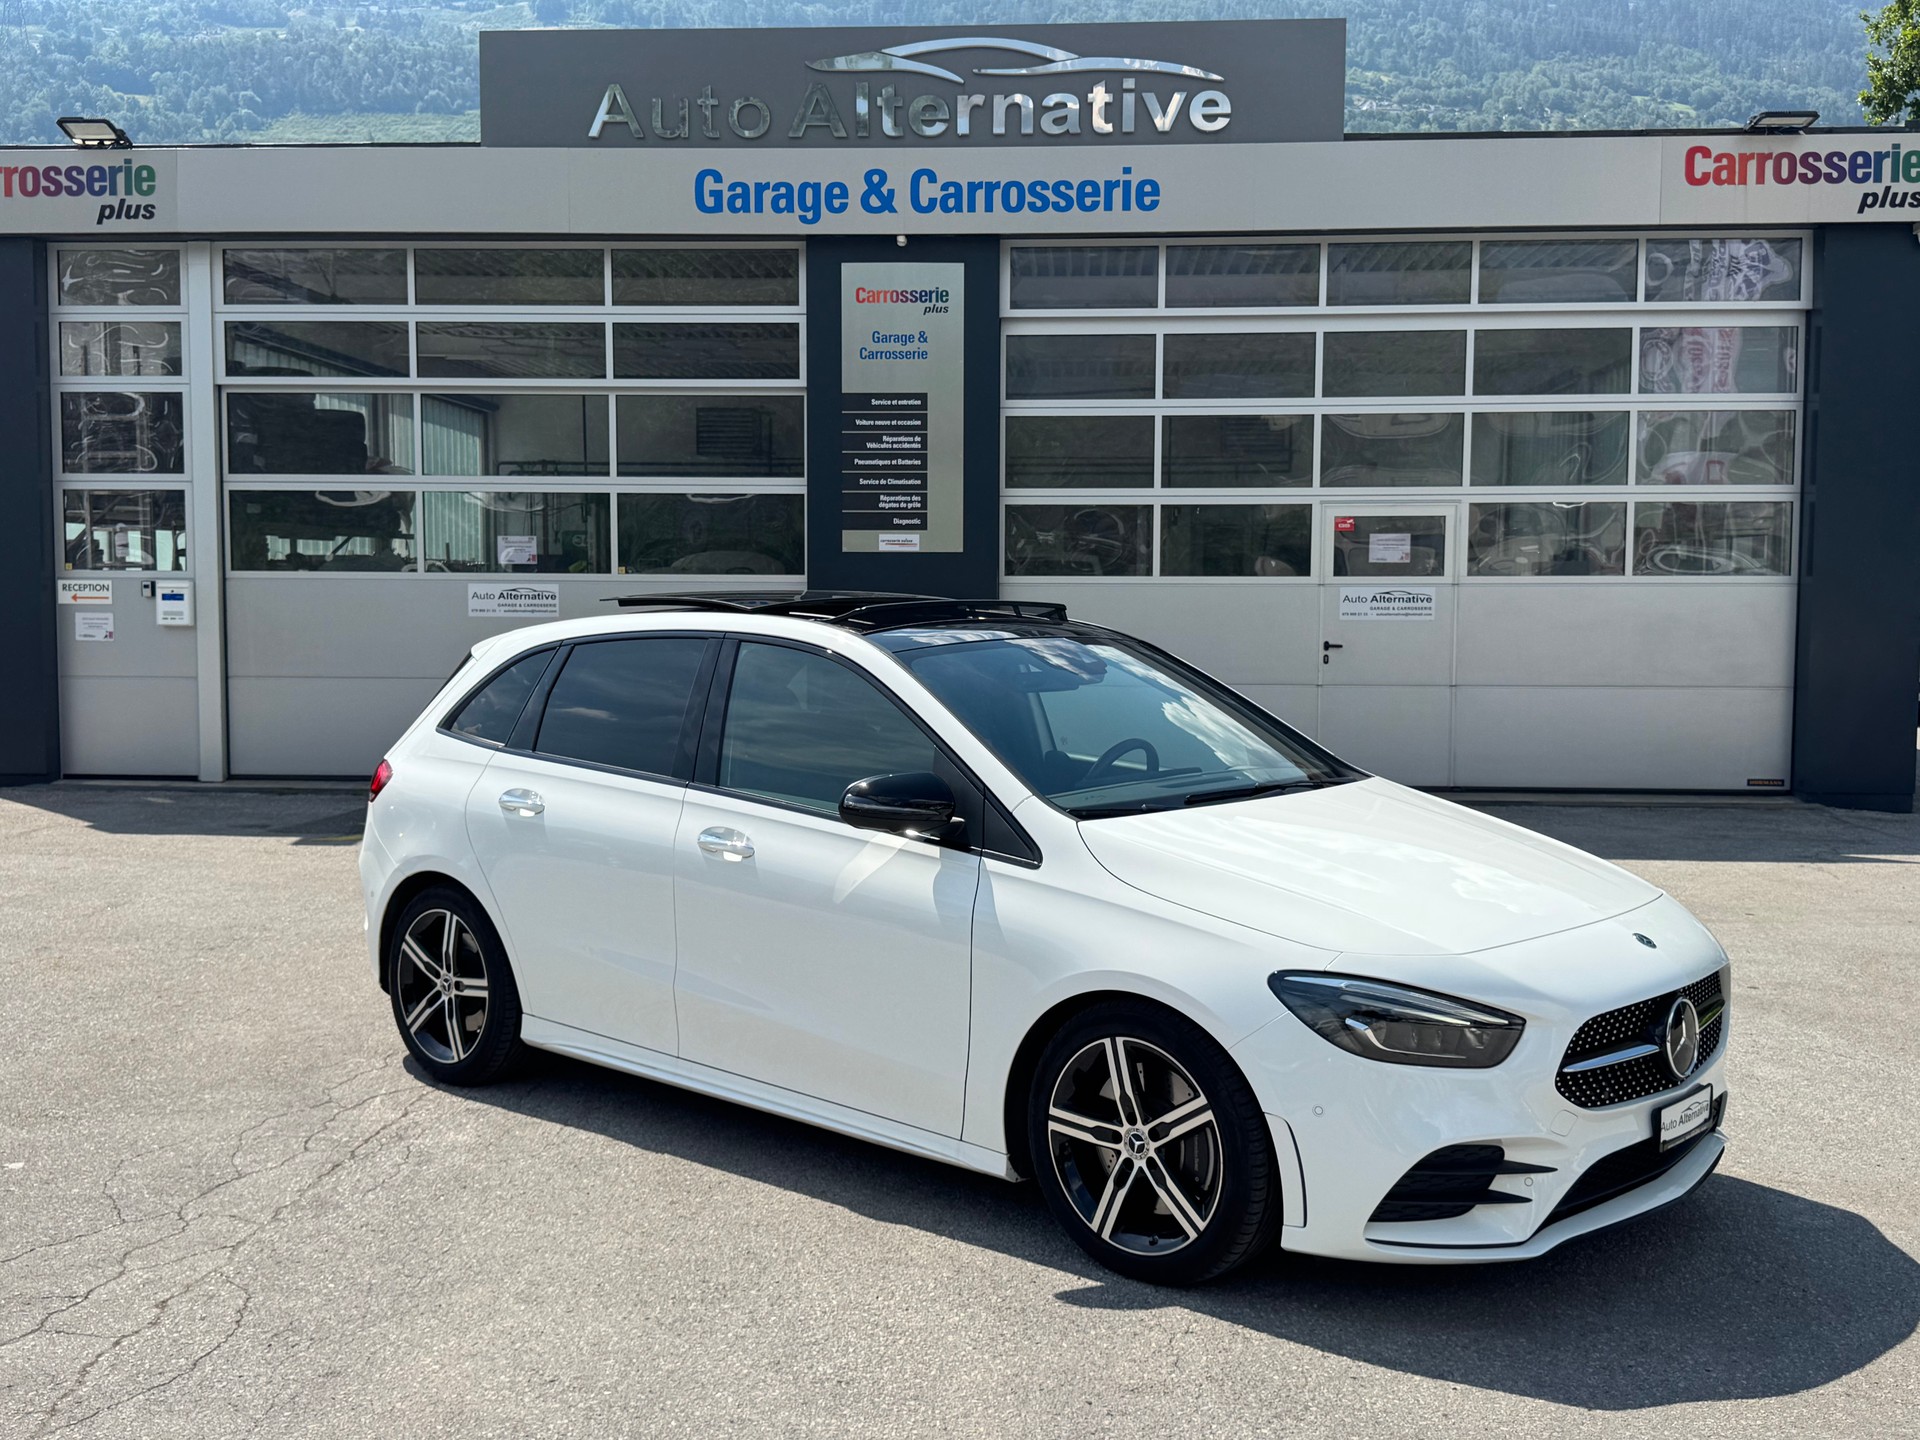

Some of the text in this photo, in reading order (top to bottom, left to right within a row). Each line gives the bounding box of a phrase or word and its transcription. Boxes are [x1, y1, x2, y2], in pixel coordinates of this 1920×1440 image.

[587, 78, 1232, 139] Auto Alternative
[1684, 143, 1920, 186] Carrosserie
[0, 158, 156, 198] rosserie
[694, 166, 1161, 224] Garage & Carrosserie
[1857, 185, 1920, 214] plus
[96, 199, 157, 225] plus
[855, 287, 949, 304] Carrosserie
[923, 304, 949, 316] plus
[872, 331, 928, 346] Garage &
[859, 347, 928, 360] Carrosserie
[871, 398, 891, 406] Service
[898, 398, 922, 406] entretien
[855, 418, 874, 426] Voiture
[898, 418, 922, 426] occasion
[882, 435, 914, 443] Réparations
[854, 458, 891, 466] Pneumatiques
[880, 494, 911, 502] Réparations
[62, 583, 110, 592] RECEPTION
[471, 592, 557, 601] Auto Alternative
[1342, 594, 1433, 604] Auto Alternative
[1661, 1103, 1709, 1132] Auto Alternative
